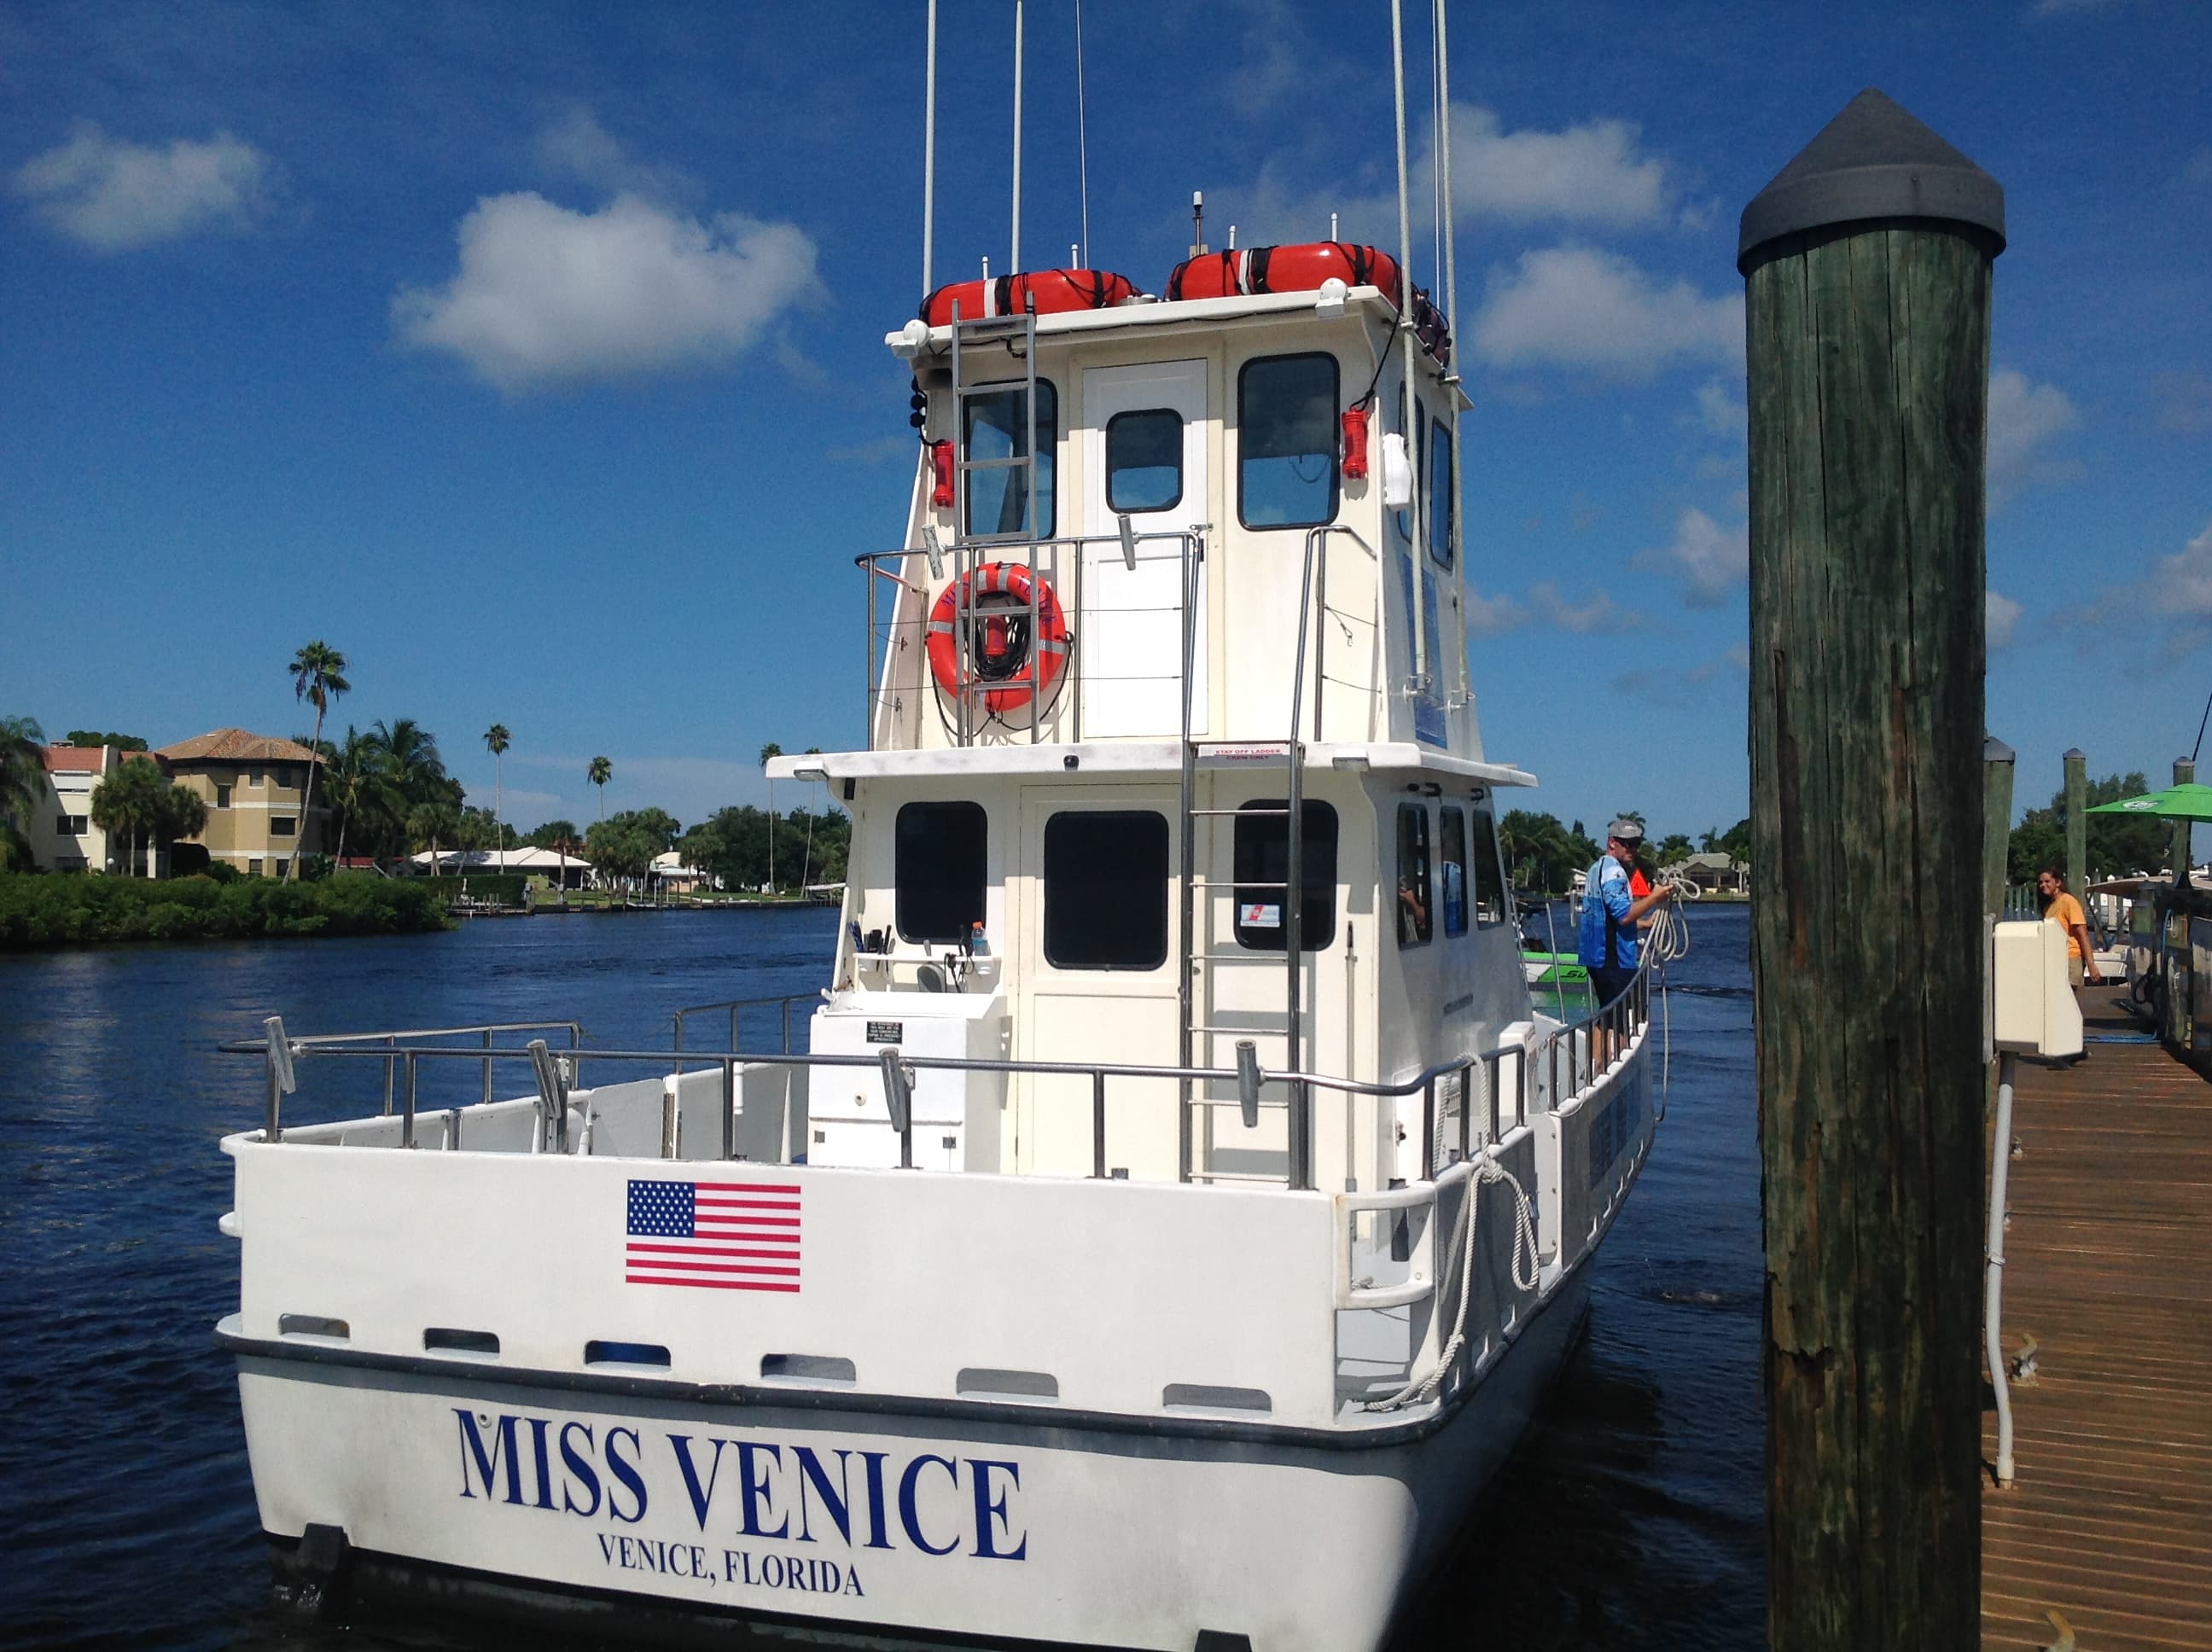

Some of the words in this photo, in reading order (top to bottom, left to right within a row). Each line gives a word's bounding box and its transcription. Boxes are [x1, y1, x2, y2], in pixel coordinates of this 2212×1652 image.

[451, 1408, 648, 1523] MISS
[666, 1434, 1027, 1562] VENICE
[597, 1533, 717, 1587] VENICE,
[723, 1550, 865, 1597] FLORIDA
